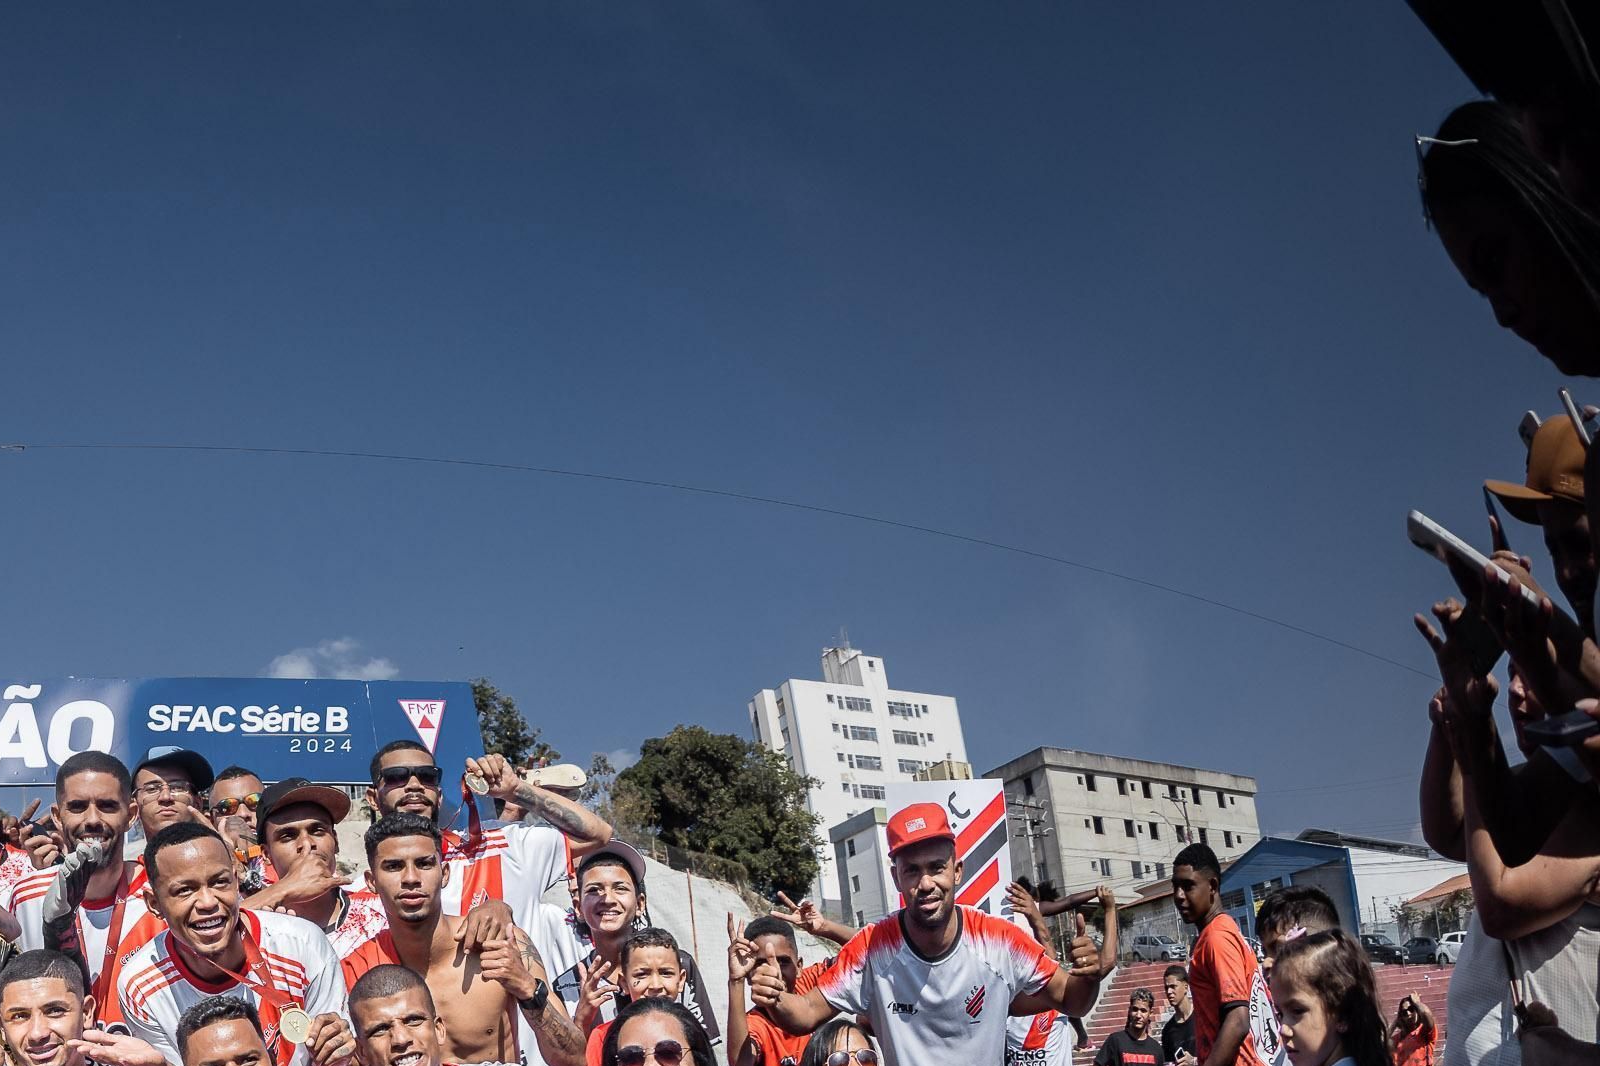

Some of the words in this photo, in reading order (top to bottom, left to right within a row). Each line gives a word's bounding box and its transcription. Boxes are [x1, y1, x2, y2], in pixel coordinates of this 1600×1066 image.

[407, 702, 437, 714] FMF
[147, 704, 236, 732] SFAC
[240, 704, 321, 733] Série
[325, 705, 349, 732] B
[289, 738, 352, 753] 2024
[1008, 1048, 1047, 1061] RENO
